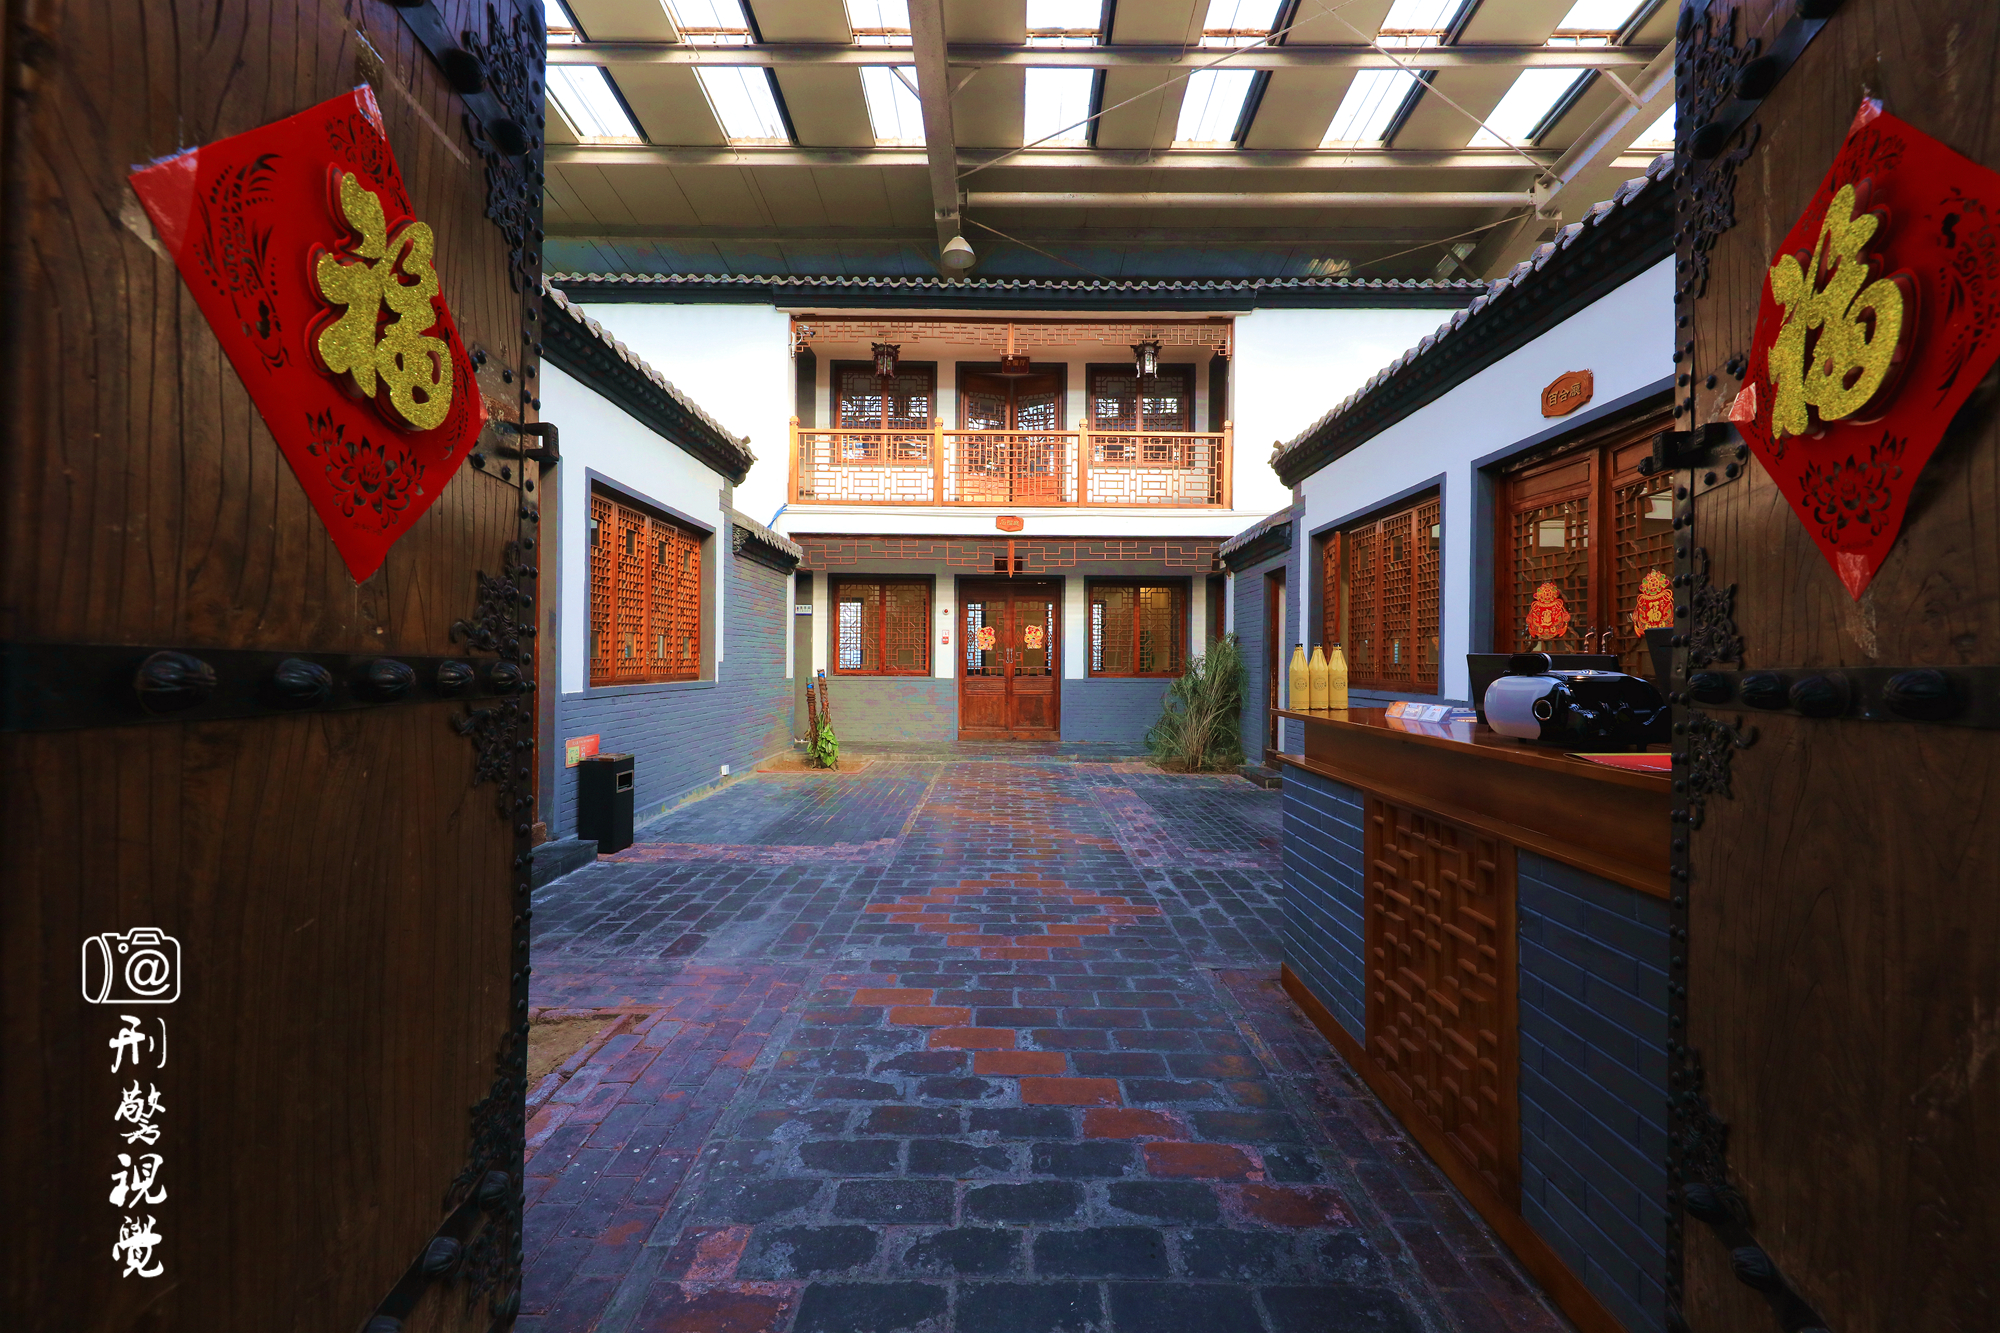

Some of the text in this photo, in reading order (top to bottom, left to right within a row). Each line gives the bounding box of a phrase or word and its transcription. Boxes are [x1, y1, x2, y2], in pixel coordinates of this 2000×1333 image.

[317, 171, 454, 431] 福
[1768, 183, 1904, 440] 福
[1647, 600, 1662, 622] 福
